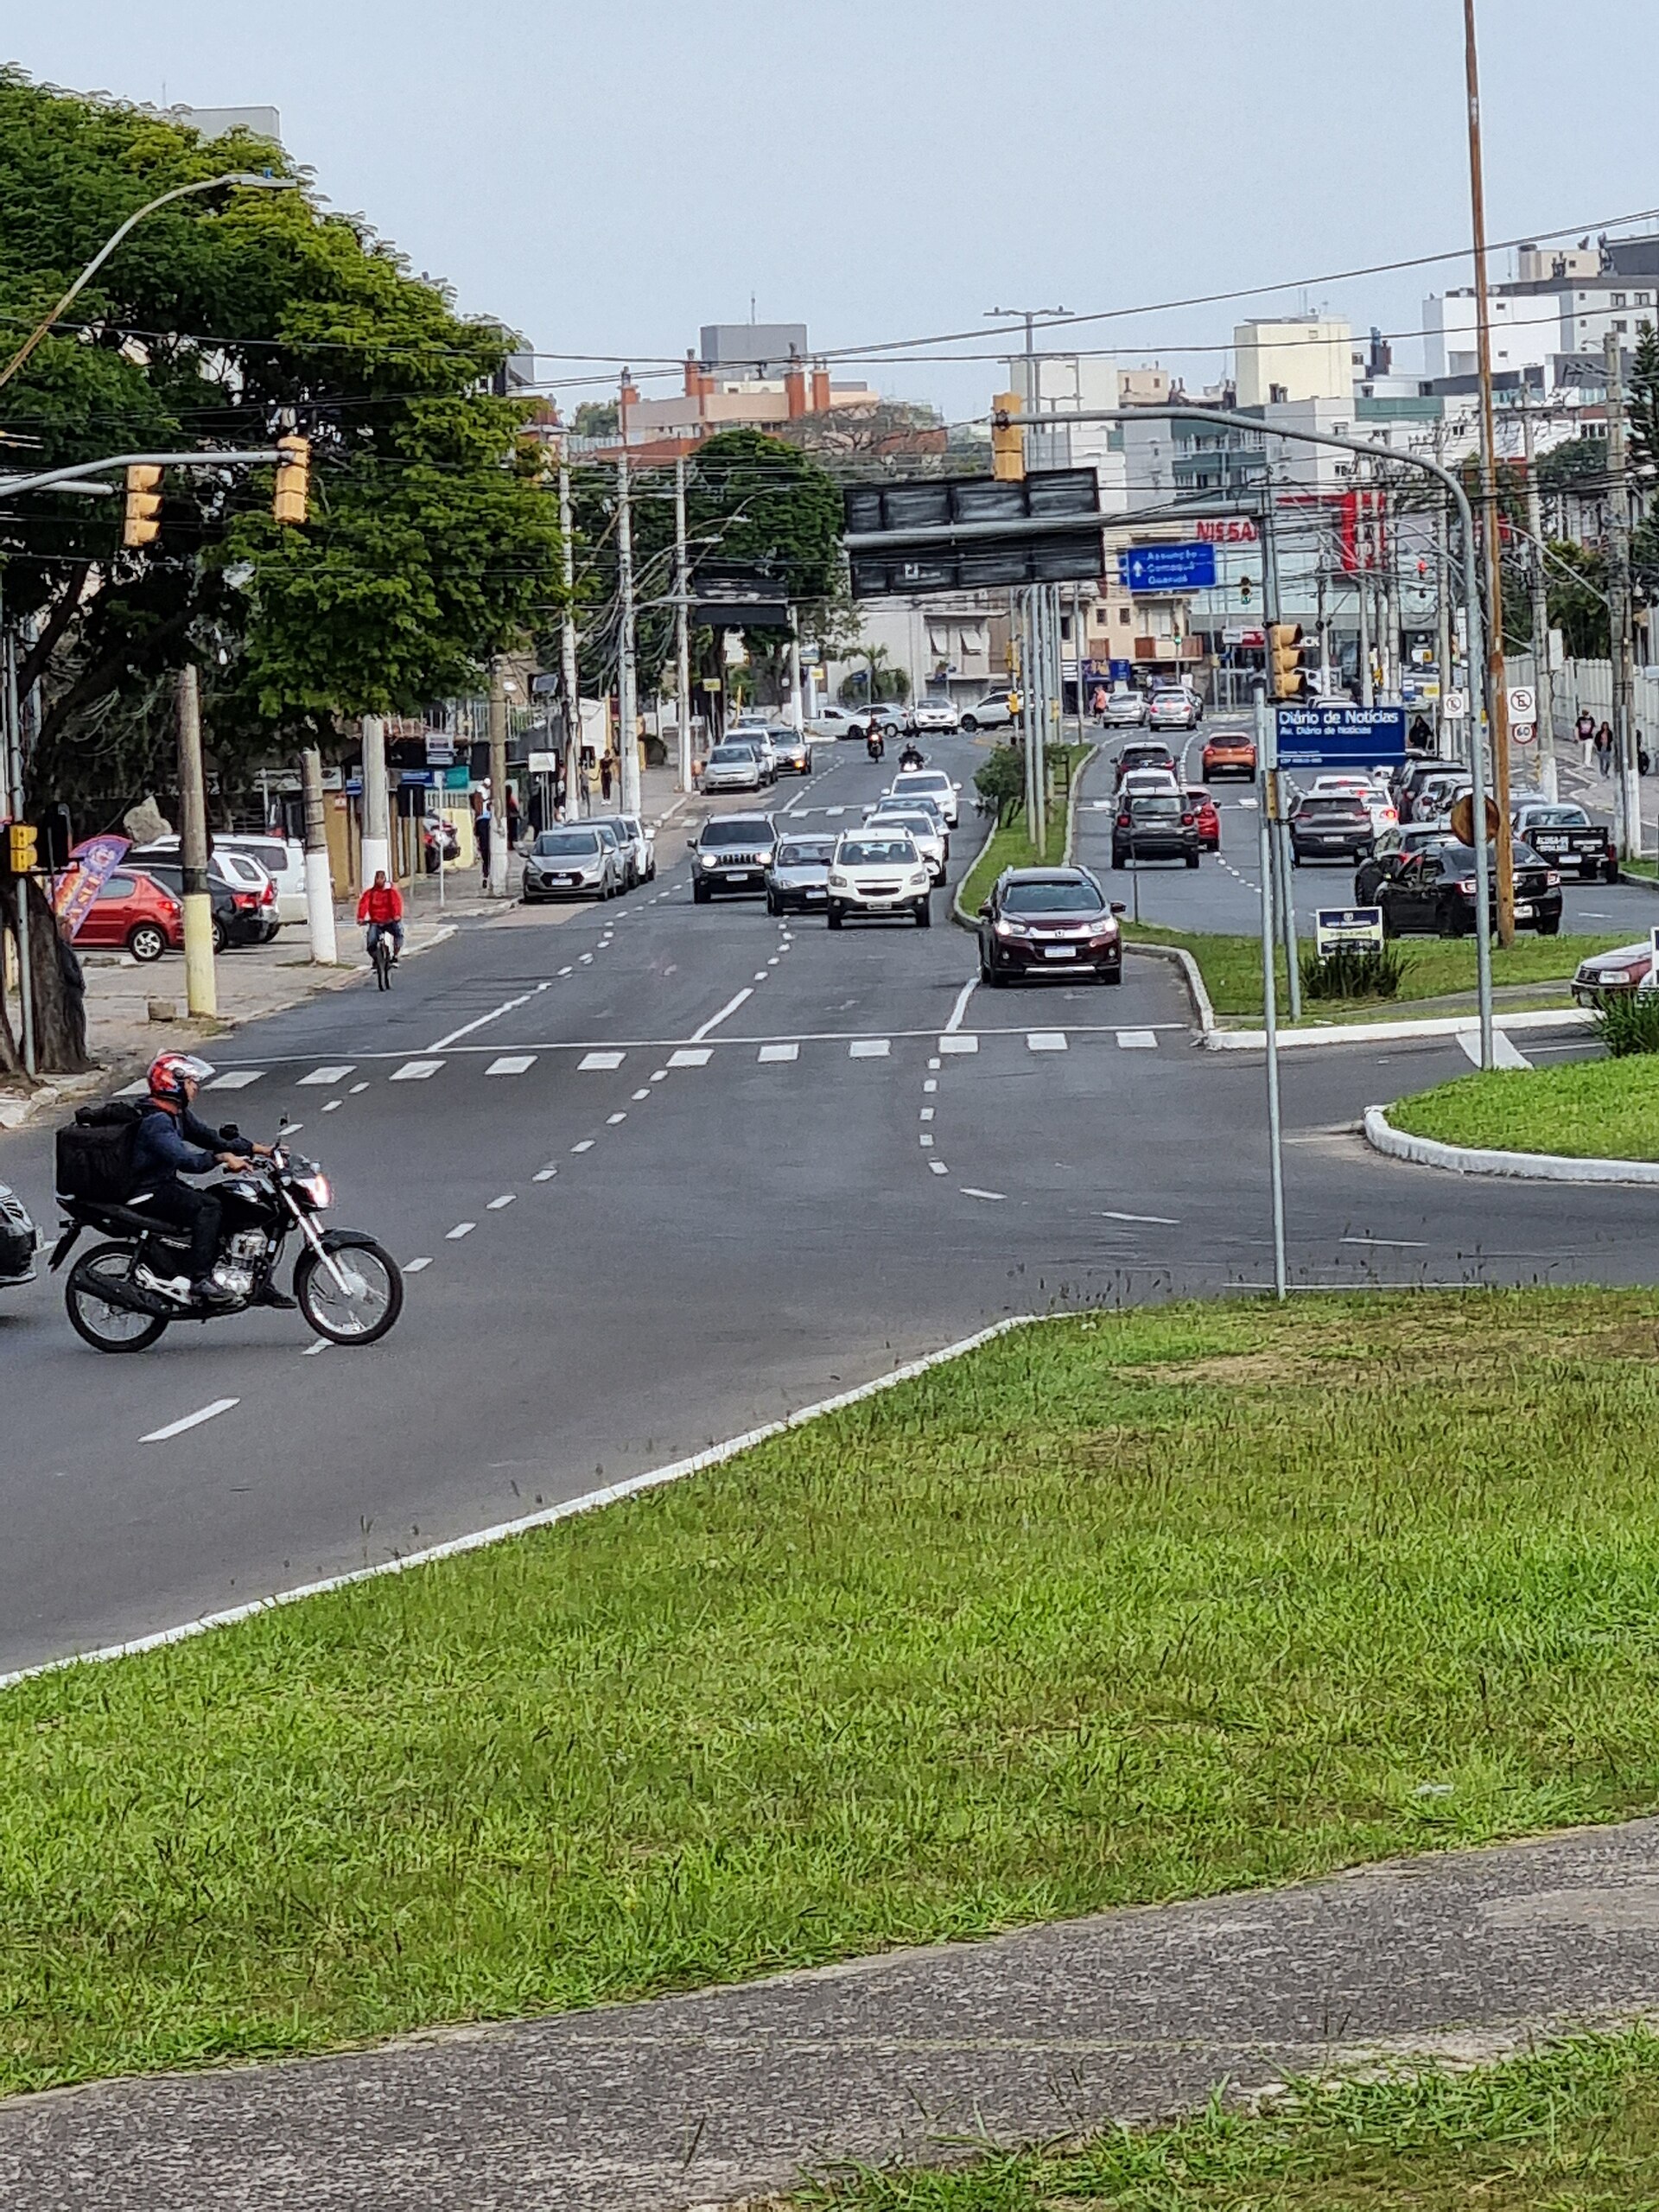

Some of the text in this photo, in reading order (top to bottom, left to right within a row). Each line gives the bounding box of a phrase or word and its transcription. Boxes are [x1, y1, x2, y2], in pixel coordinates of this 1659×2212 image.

[1197, 520, 1259, 542] NISSA
[1279, 709, 1399, 725] Diário de Notícias
[1324, 727, 1336, 735] de
[1516, 727, 1530, 736] 60
